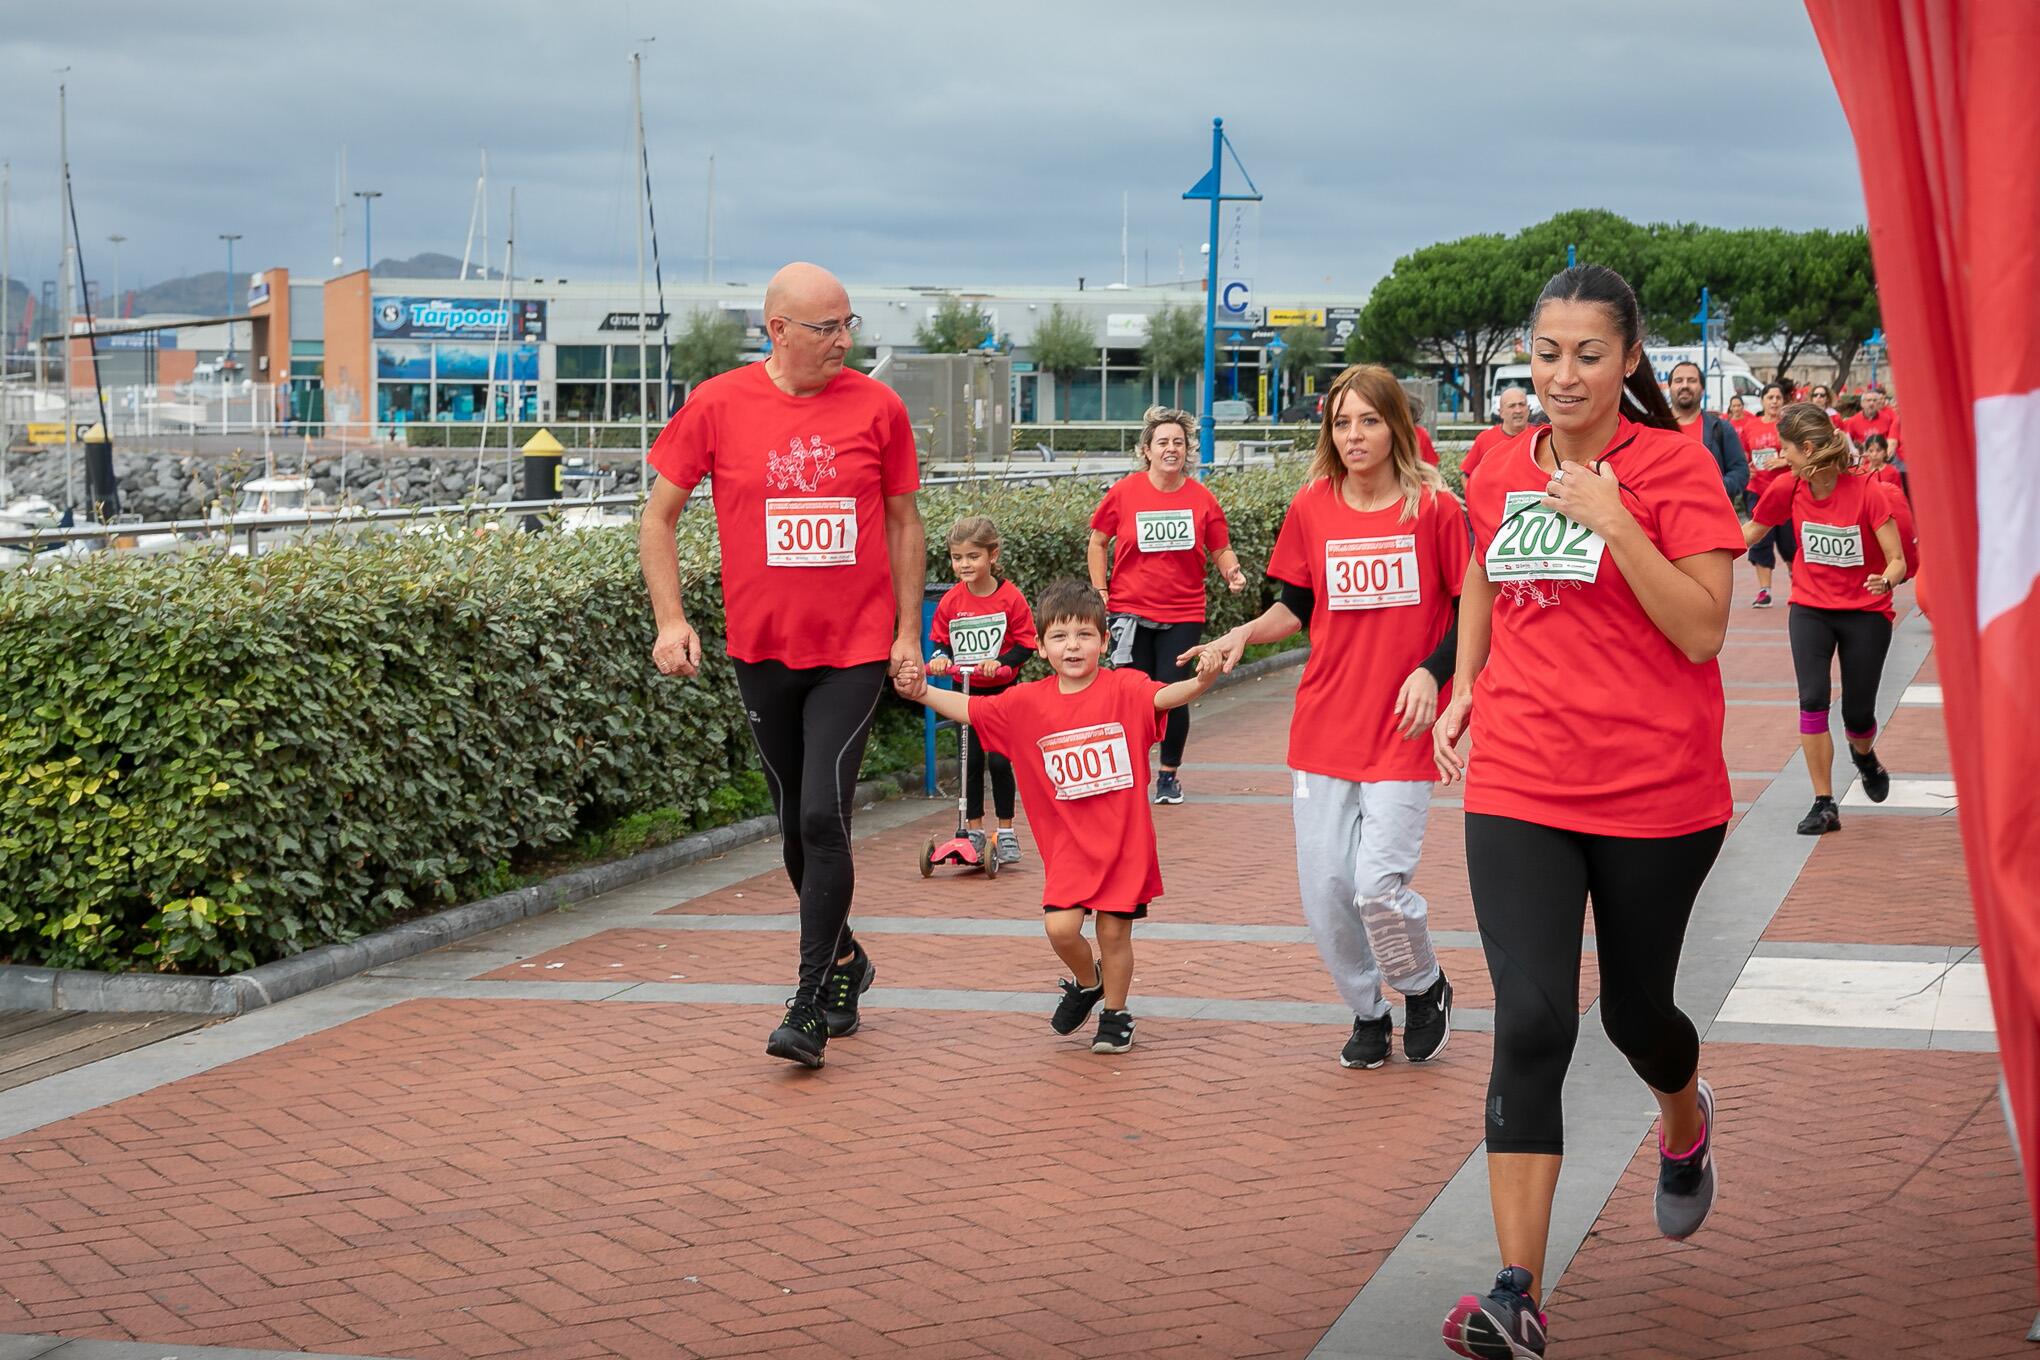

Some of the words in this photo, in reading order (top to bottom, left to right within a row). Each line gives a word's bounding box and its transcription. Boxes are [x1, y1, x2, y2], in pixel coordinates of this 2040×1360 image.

[1223, 282, 1249, 313] C
[411, 303, 508, 331] Tarpoon
[777, 518, 846, 551] 3001
[1144, 521, 1189, 541] 2002
[1497, 511, 1594, 556] 2002
[1809, 535, 1856, 556] 2002
[1336, 557, 1404, 593] 3001
[955, 627, 1002, 652] 2002
[1051, 743, 1117, 786] 3001
